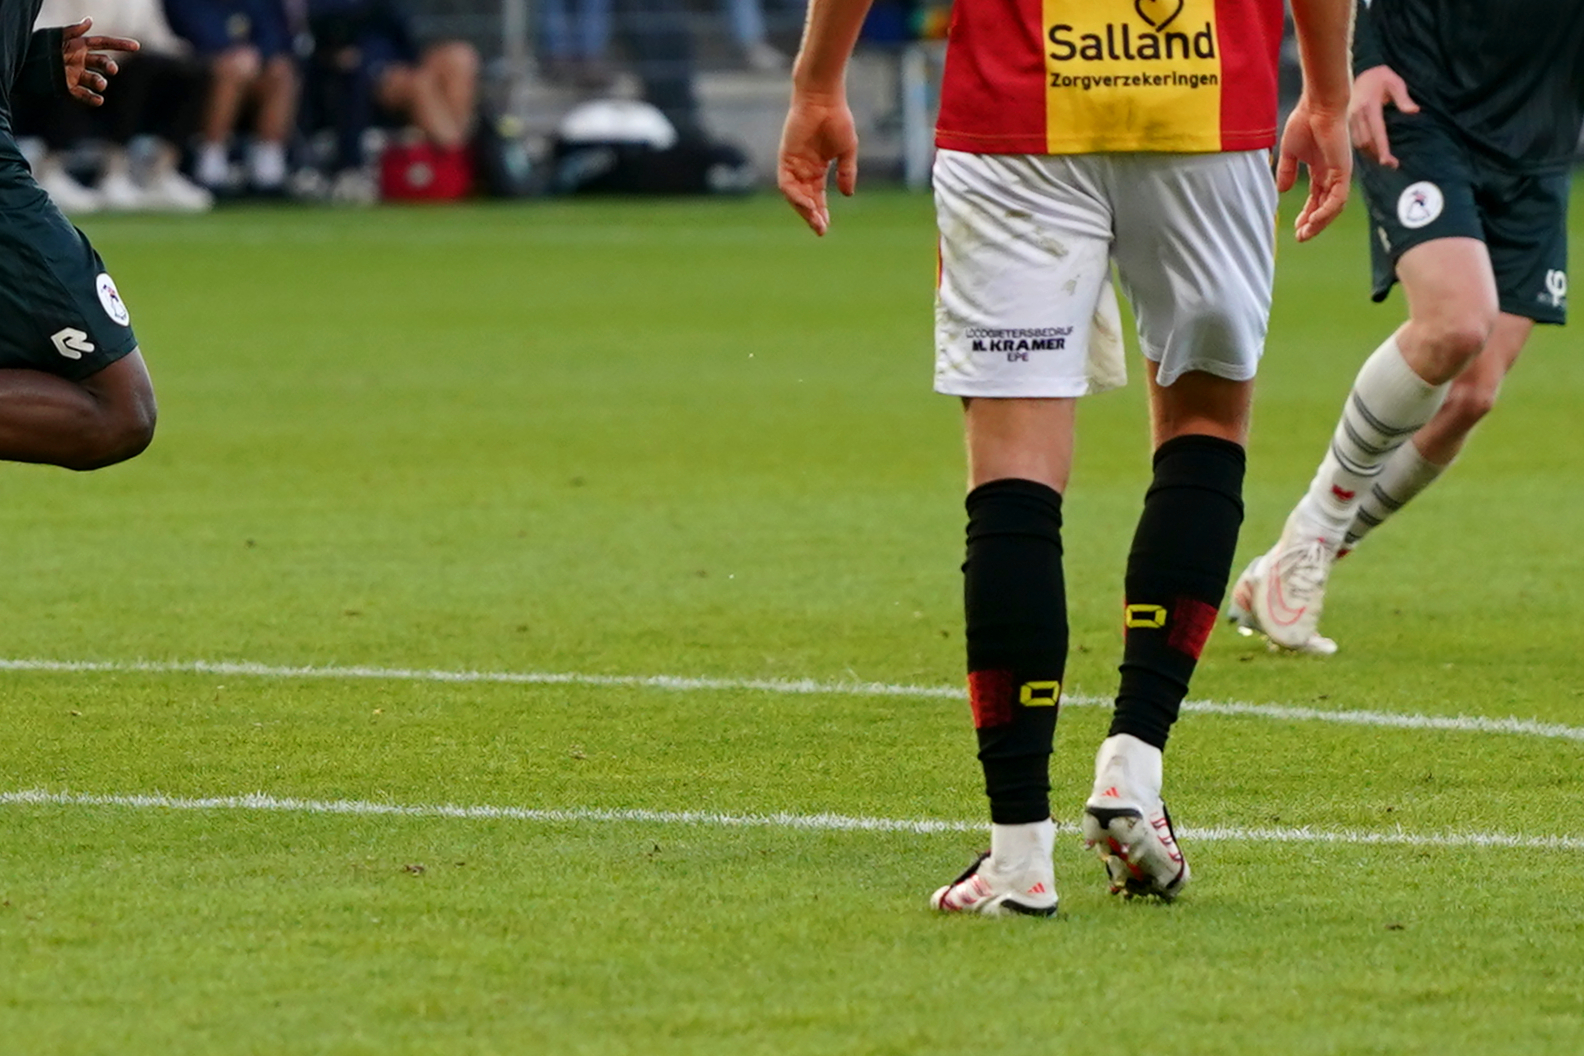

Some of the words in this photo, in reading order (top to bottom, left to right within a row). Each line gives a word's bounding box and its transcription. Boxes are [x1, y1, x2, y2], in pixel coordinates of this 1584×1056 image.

[1048, 21, 1216, 61] Salland
[1050, 72, 1219, 90] Zorgverzekeringen
[989, 338, 1065, 352] KRAMER
